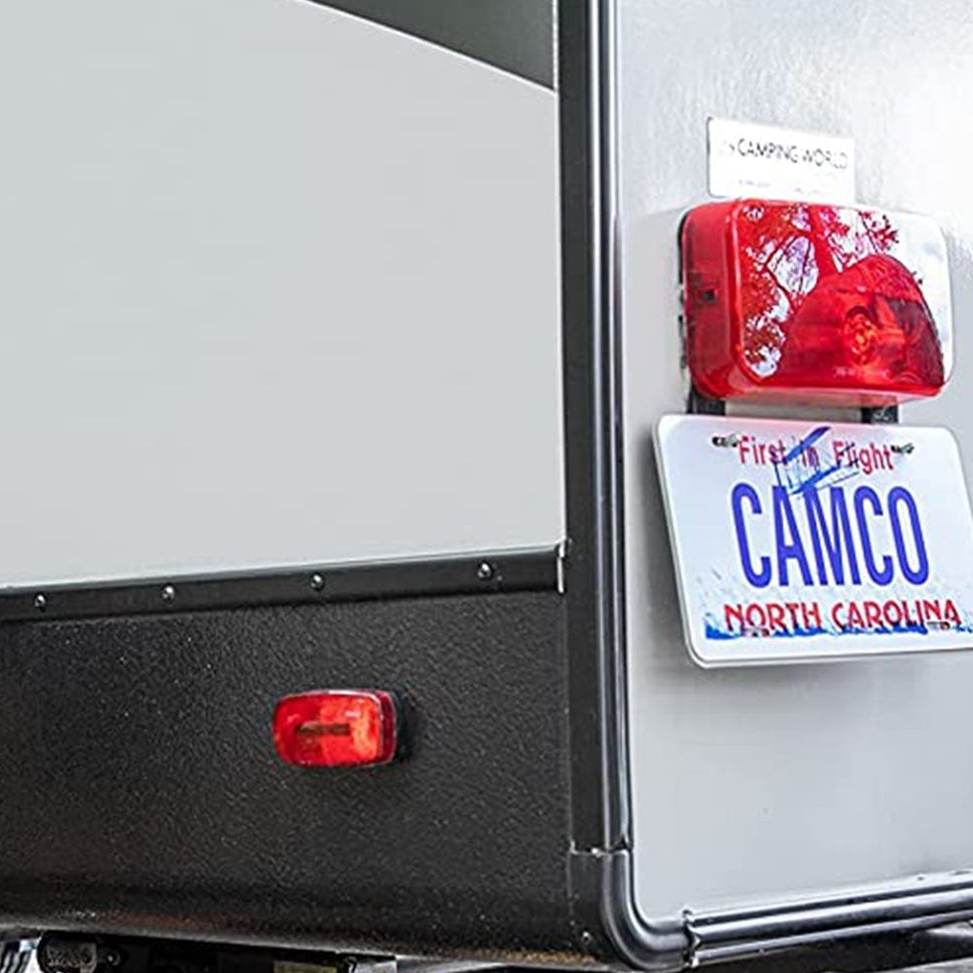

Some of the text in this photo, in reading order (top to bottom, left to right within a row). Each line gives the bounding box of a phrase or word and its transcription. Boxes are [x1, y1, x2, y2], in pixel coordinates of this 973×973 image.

[737, 436, 786, 465] First
[832, 440, 894, 475] Flight
[731, 482, 930, 588] CAMCO
[724, 599, 962, 632] NORTH CAROLINA
